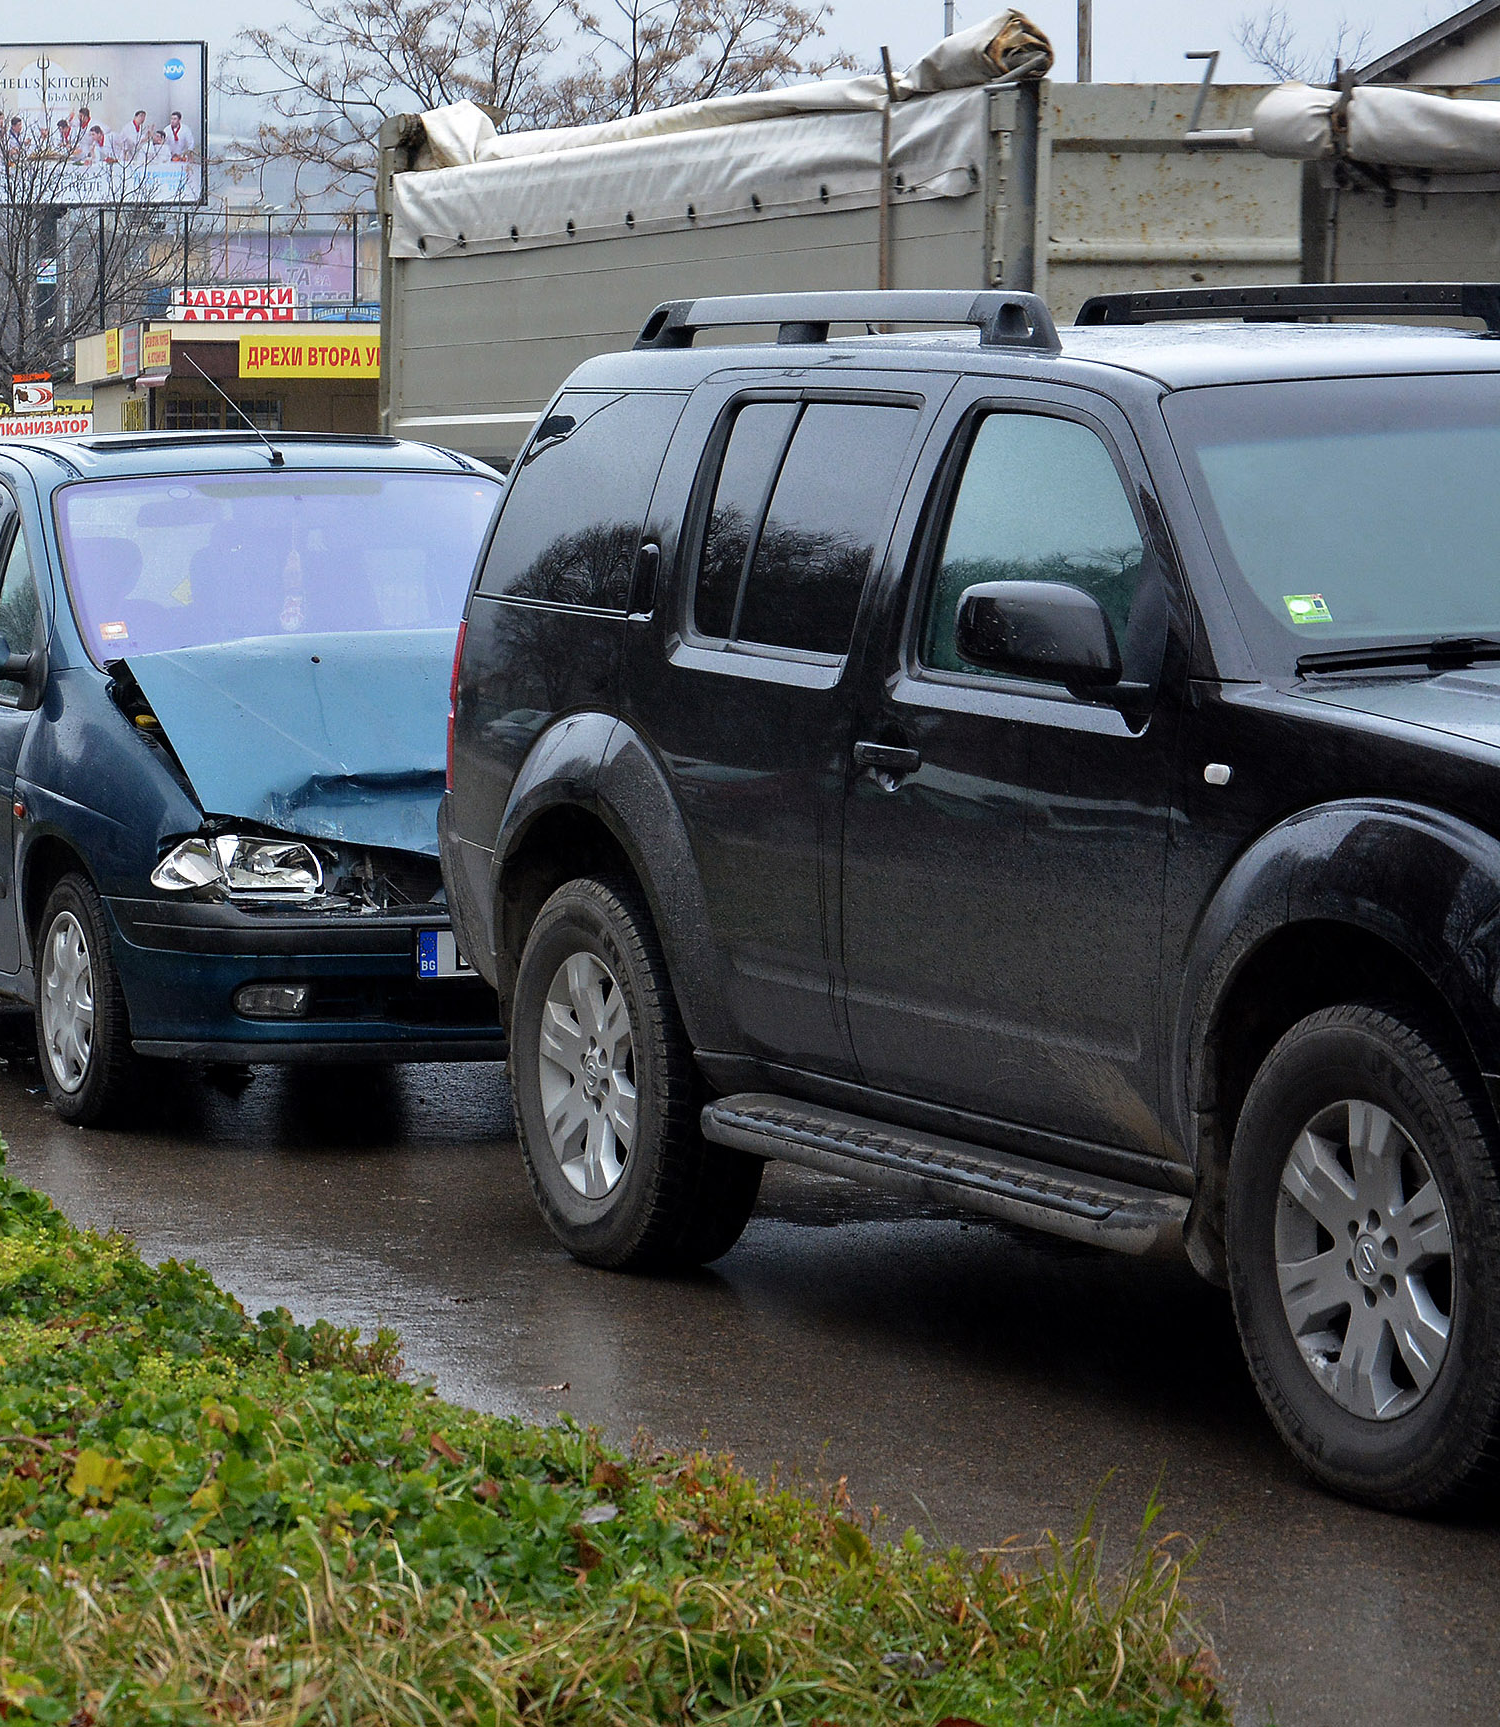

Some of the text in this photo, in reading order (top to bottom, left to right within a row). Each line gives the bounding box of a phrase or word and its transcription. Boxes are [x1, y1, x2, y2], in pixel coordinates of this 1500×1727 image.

[164, 66, 184, 74] NOVA
[47, 77, 109, 88] KITCHEN
[179, 288, 293, 306] ЗАВАРКИ
[247, 347, 302, 369] ДРЕХИ
[308, 347, 361, 366] ВТОРА
[421, 960, 436, 970] BG
